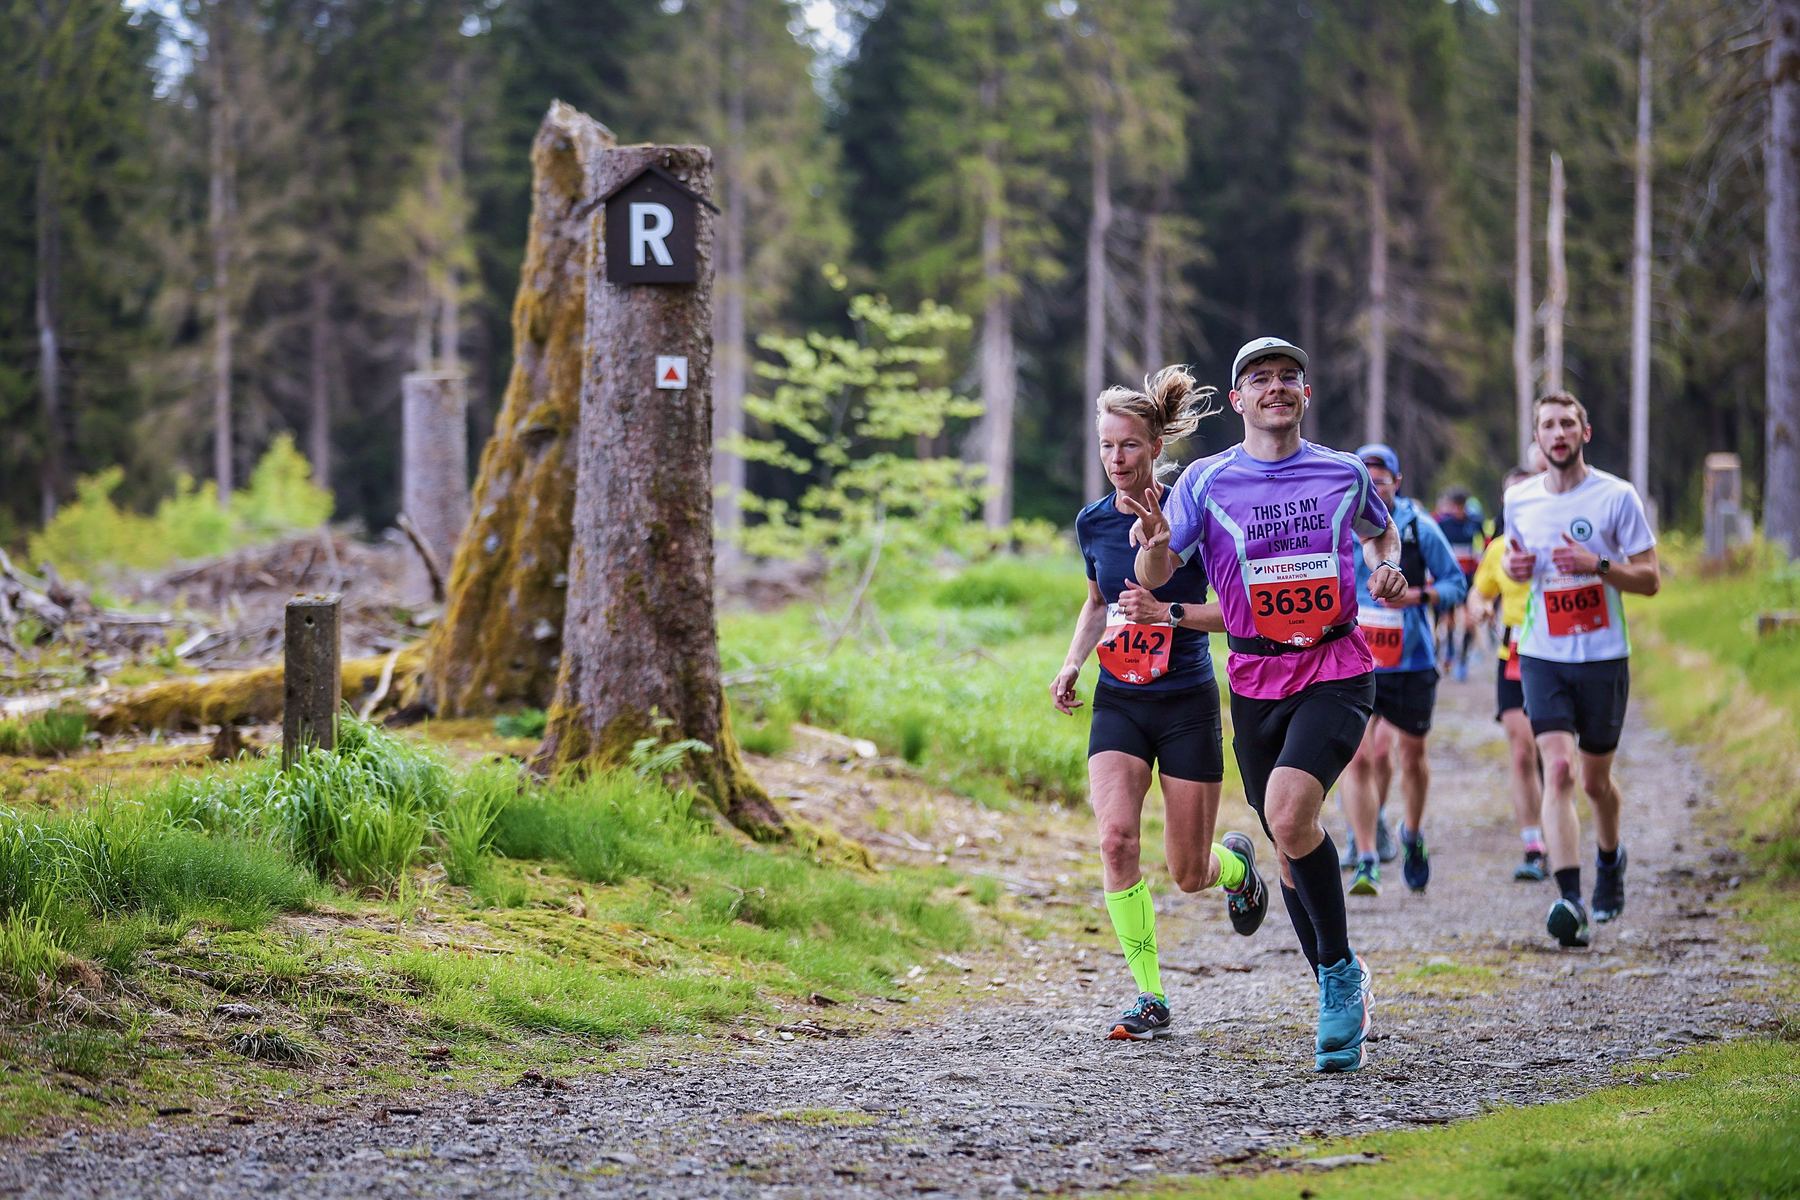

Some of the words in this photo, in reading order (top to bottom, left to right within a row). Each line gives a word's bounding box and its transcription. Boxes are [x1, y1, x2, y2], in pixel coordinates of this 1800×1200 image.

[629, 202, 674, 266] R
[1252, 504, 1282, 520] THIS
[1284, 502, 1297, 517] IS
[1299, 497, 1318, 513] MY
[1247, 520, 1290, 540] HAPPY
[1294, 514, 1329, 533] FACE.
[1268, 542, 1272, 553] I
[1274, 536, 1312, 553] SWEAR.
[1264, 560, 1328, 574] INTERSPORT
[1256, 585, 1334, 616] 3636
[1548, 588, 1601, 613] 3663
